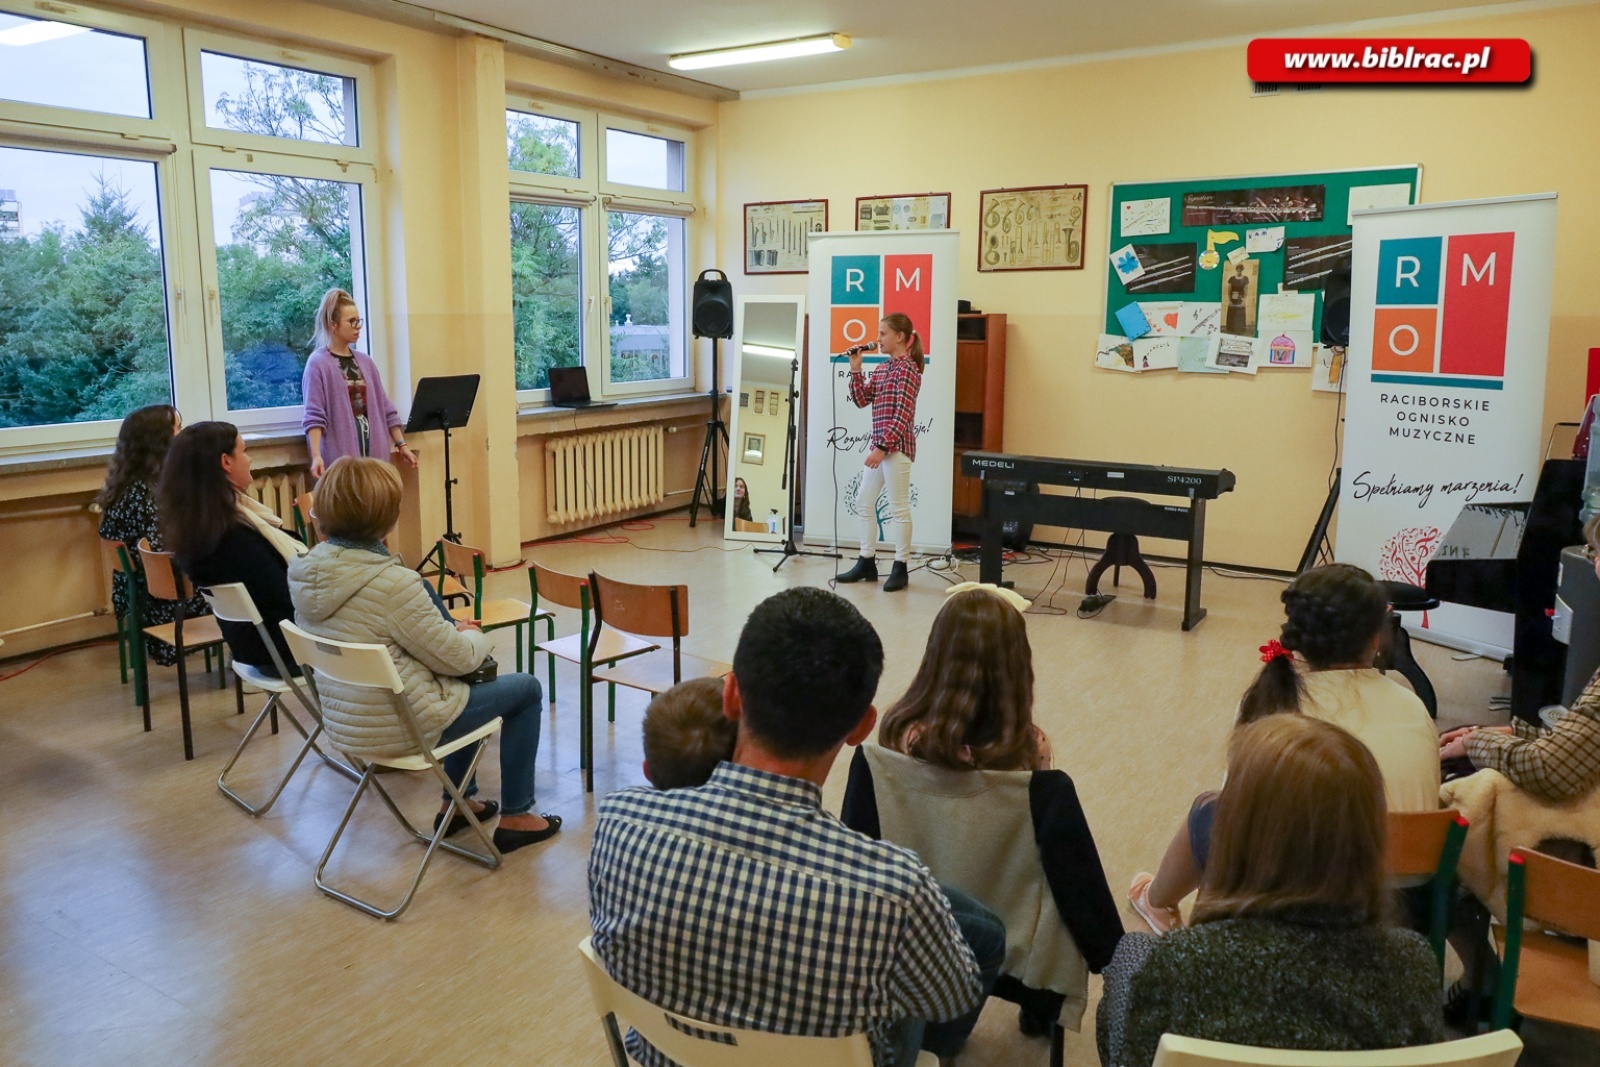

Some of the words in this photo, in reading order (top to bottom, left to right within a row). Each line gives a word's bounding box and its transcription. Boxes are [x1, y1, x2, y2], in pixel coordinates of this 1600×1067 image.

[845, 268, 865, 292] R
[895, 267, 921, 292] M
[1395, 255, 1421, 288] R
[1461, 251, 1497, 286] M
[842, 318, 867, 343] O
[1388, 324, 1420, 356] O
[1380, 393, 1490, 411] RACIBORSKIE
[1396, 411, 1470, 427] OGNISKO
[1389, 426, 1476, 445] MUZYCZNE
[972, 458, 1015, 469] MEDELI
[1167, 474, 1202, 485] SP4200
[1352, 470, 1434, 509] Spełniamy
[1440, 473, 1524, 502] marzenia!
